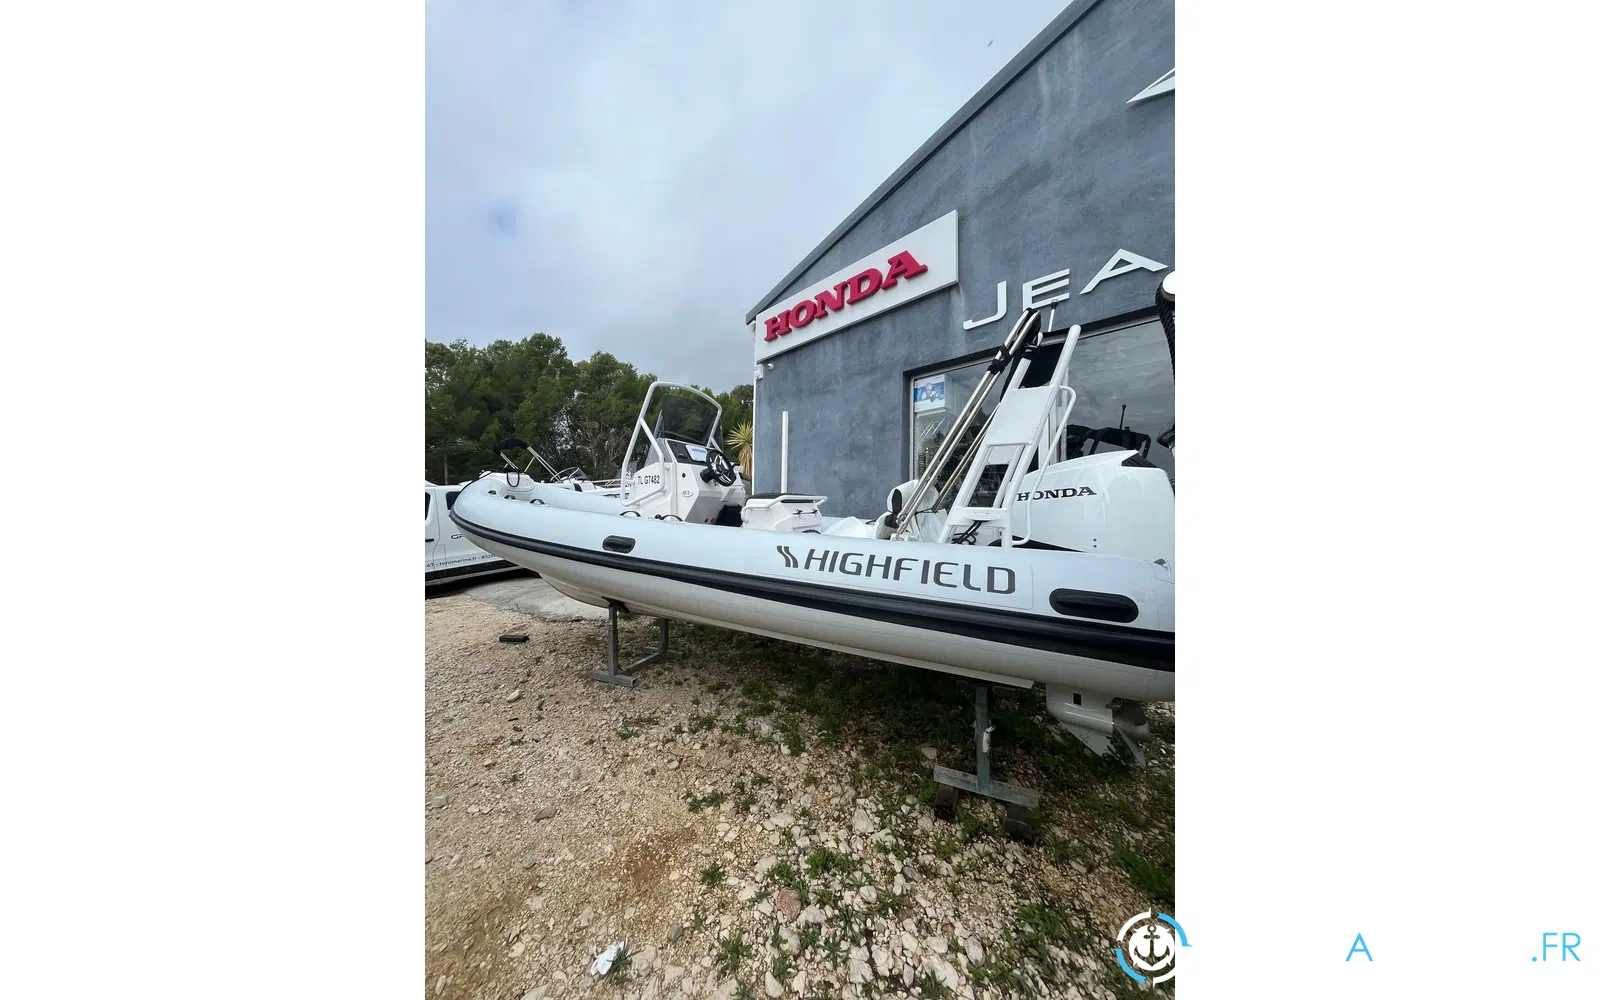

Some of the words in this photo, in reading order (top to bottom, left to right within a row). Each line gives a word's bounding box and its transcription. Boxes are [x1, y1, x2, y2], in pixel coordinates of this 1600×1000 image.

[763, 250, 928, 342] HONDA
[963, 248, 1169, 331] JEA
[637, 475, 644, 485] TL
[1016, 486, 1097, 502] HONDA
[803, 548, 1016, 595] HIGHFIELD
